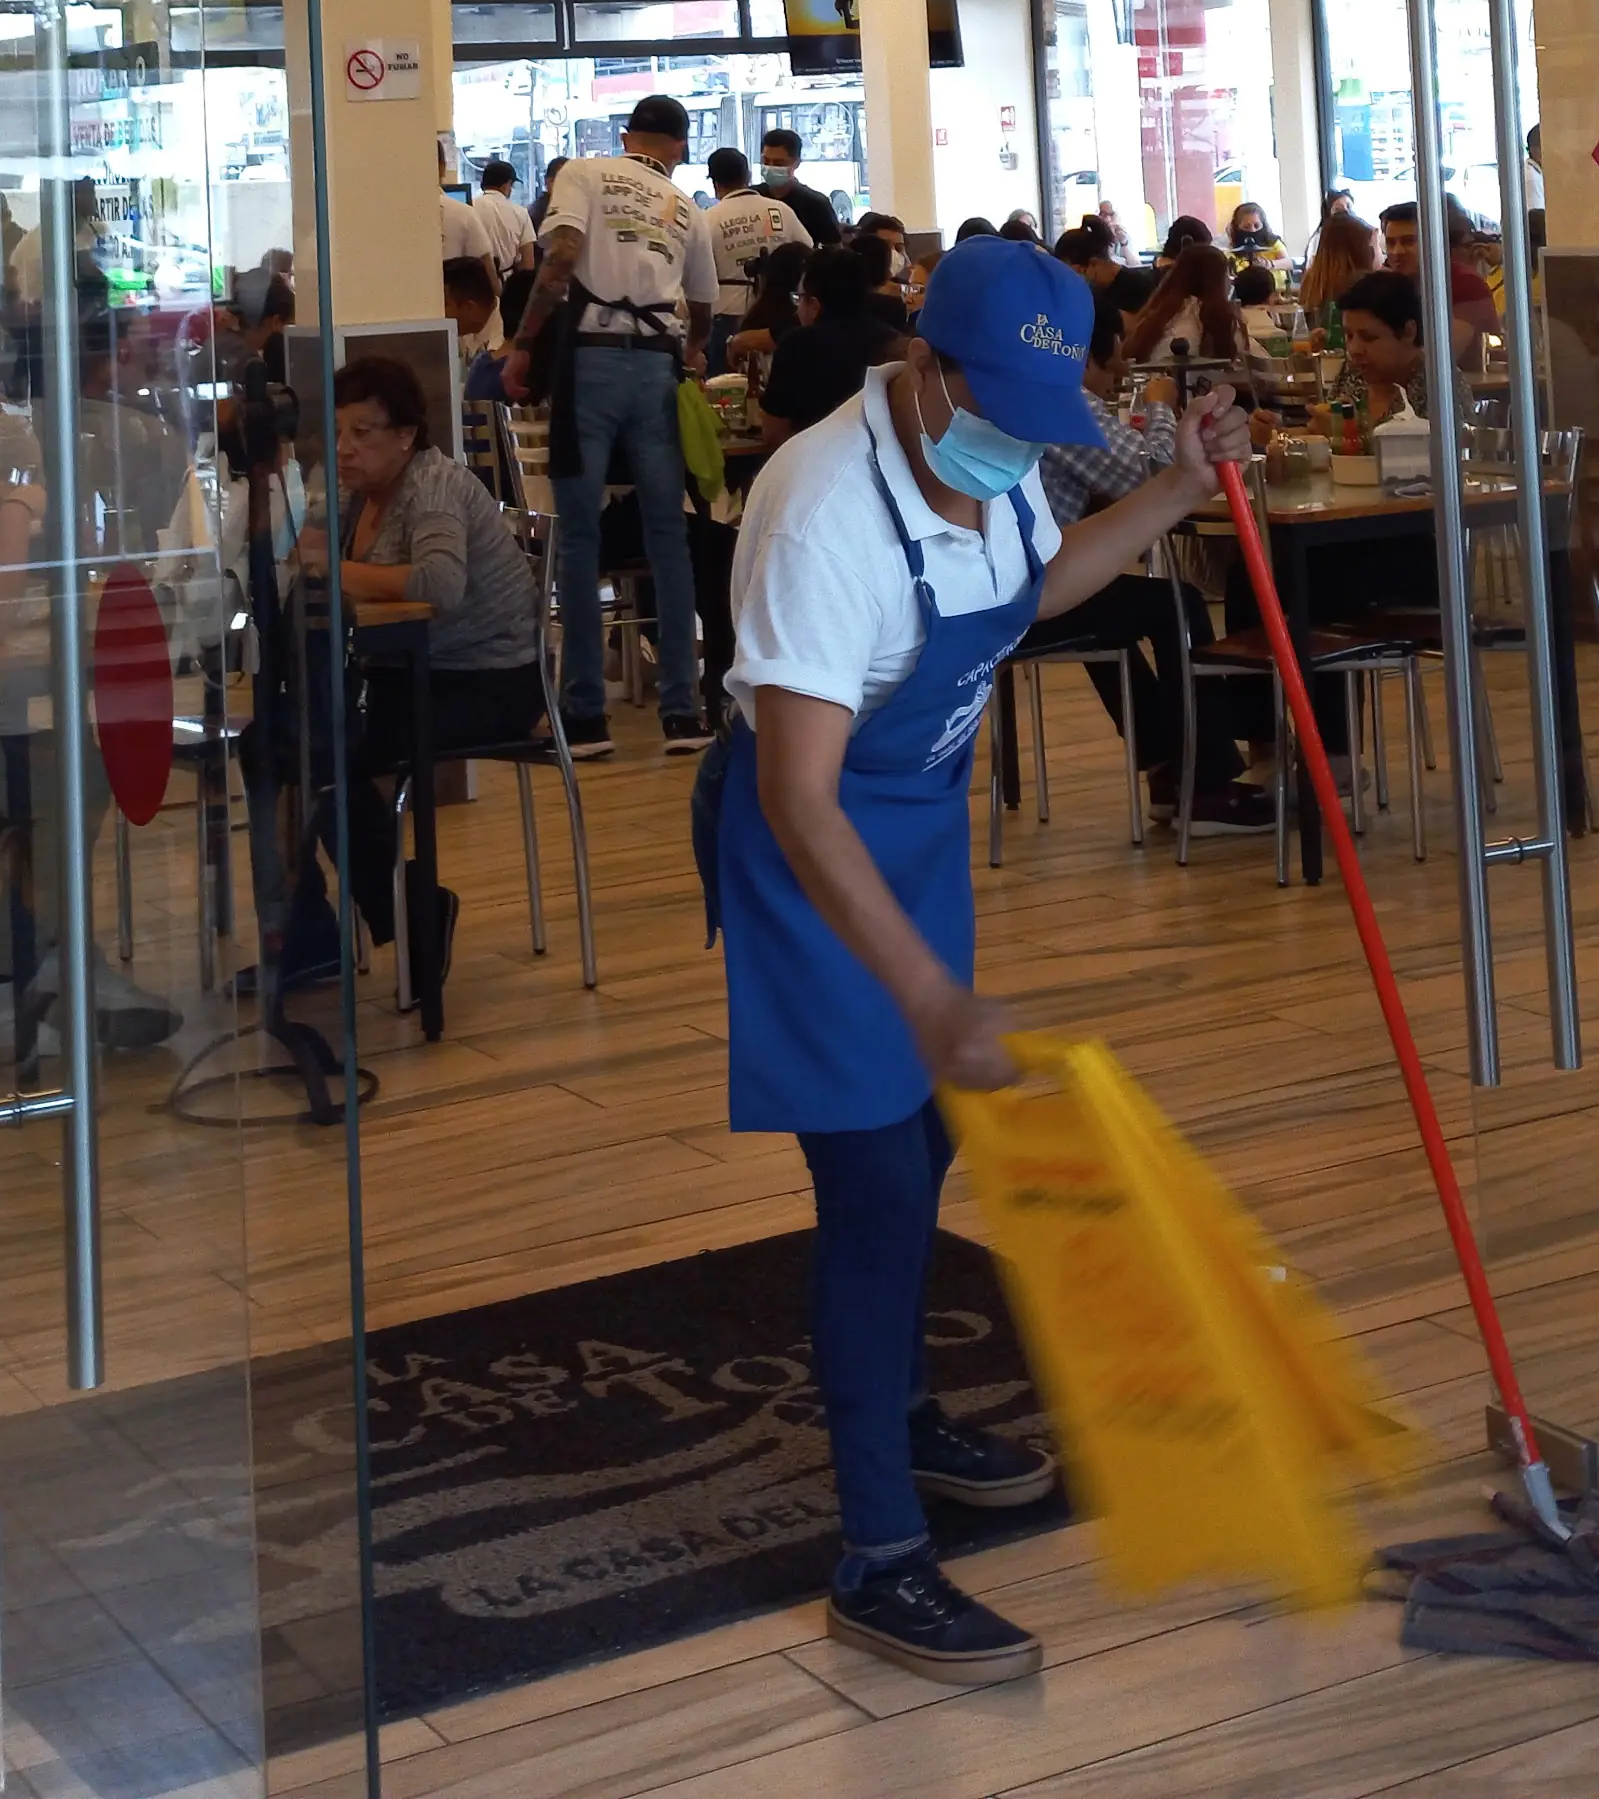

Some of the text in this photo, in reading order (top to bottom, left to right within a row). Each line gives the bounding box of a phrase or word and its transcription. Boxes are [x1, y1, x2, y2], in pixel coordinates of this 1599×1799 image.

[396, 52, 409, 60] NO
[1036, 313, 1049, 326] LA
[1020, 324, 1064, 343] CASA
[1033, 337, 1050, 349] DE
[581, 1310, 993, 1422] TOO
[292, 1338, 670, 1458] CASA
